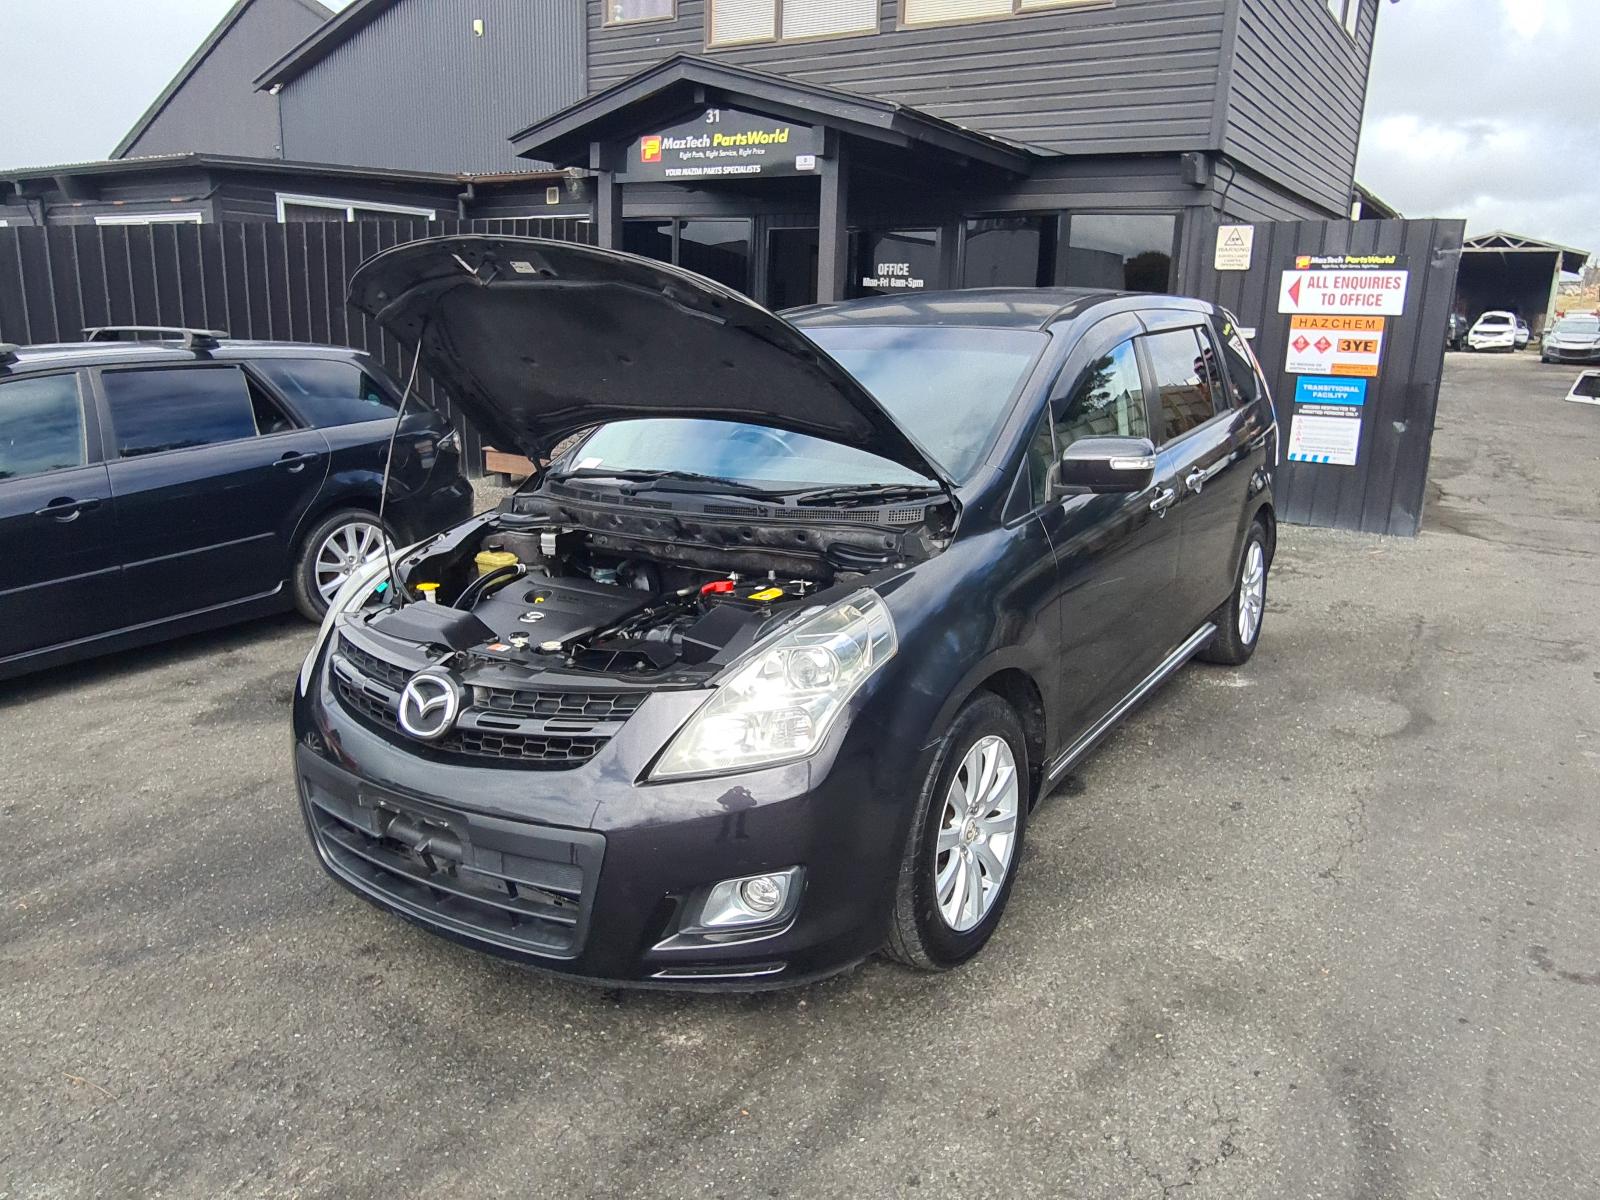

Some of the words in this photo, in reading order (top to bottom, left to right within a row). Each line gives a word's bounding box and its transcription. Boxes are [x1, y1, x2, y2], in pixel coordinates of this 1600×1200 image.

[706, 109, 720, 123] 31
[661, 134, 711, 149] MazTech
[713, 128, 790, 147] PartsWorld
[665, 168, 682, 176] YOUR
[682, 167, 702, 175] MAZDA
[703, 166, 722, 175] PARTS
[723, 165, 761, 174] SPECIALISTS
[878, 263, 910, 276] OFFICE
[1307, 276, 1329, 289] ALL
[1333, 276, 1402, 290] ENQUIRIES
[1321, 293, 1336, 306] TO
[1339, 293, 1384, 307] OFFICE
[1299, 318, 1376, 329] HAZCHEM
[1341, 340, 1374, 352] 3YE
[1303, 384, 1360, 393] TRANSITIONAL
[1312, 391, 1348, 399] FACILITY
